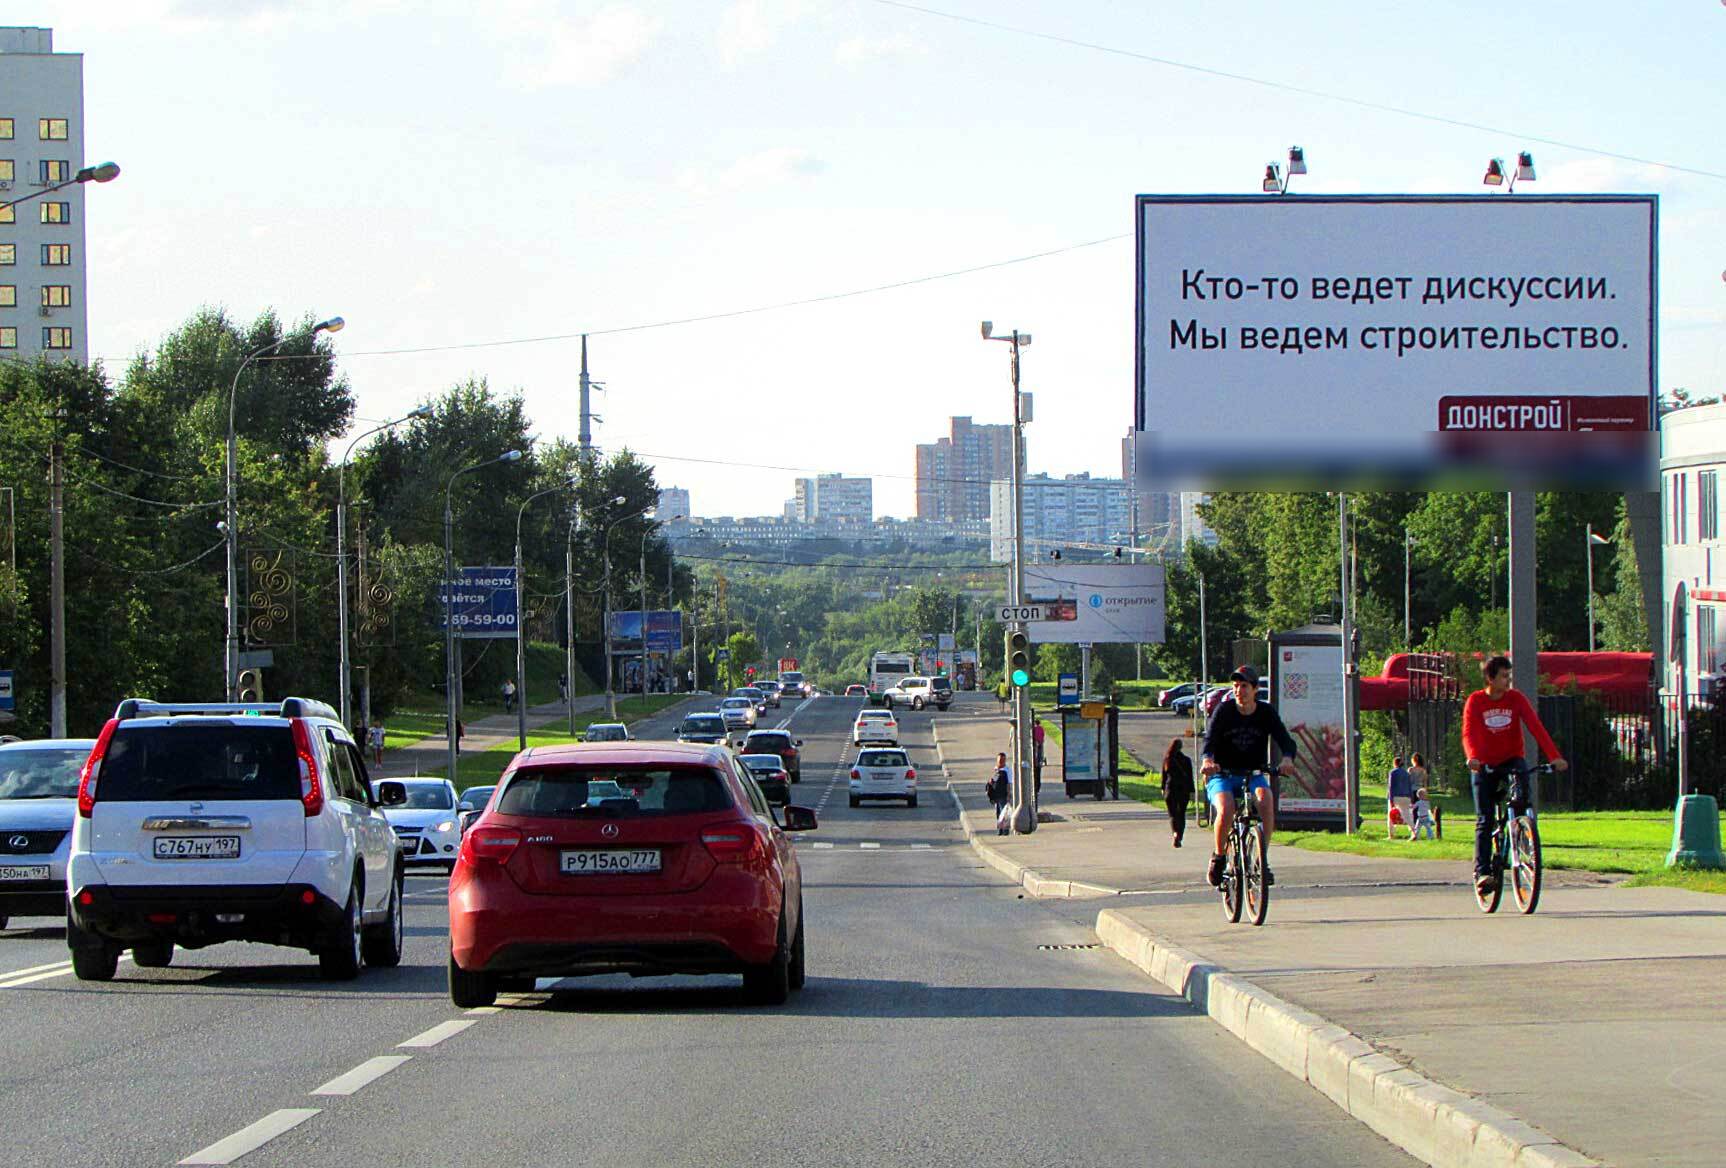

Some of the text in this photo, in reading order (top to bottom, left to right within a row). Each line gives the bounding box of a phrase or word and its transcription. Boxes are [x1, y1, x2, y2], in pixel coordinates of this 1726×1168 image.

[1182, 269, 1616, 307] Кто-то ведет дискуссии.
[1170, 319, 1628, 357] Мы ведем строительство.
[1446, 400, 1562, 429] ДОНСТРОЙ
[1001, 607, 1040, 620] СТОП
[215, 839, 235, 849] 197
[567, 851, 656, 869] Р915АО 777
